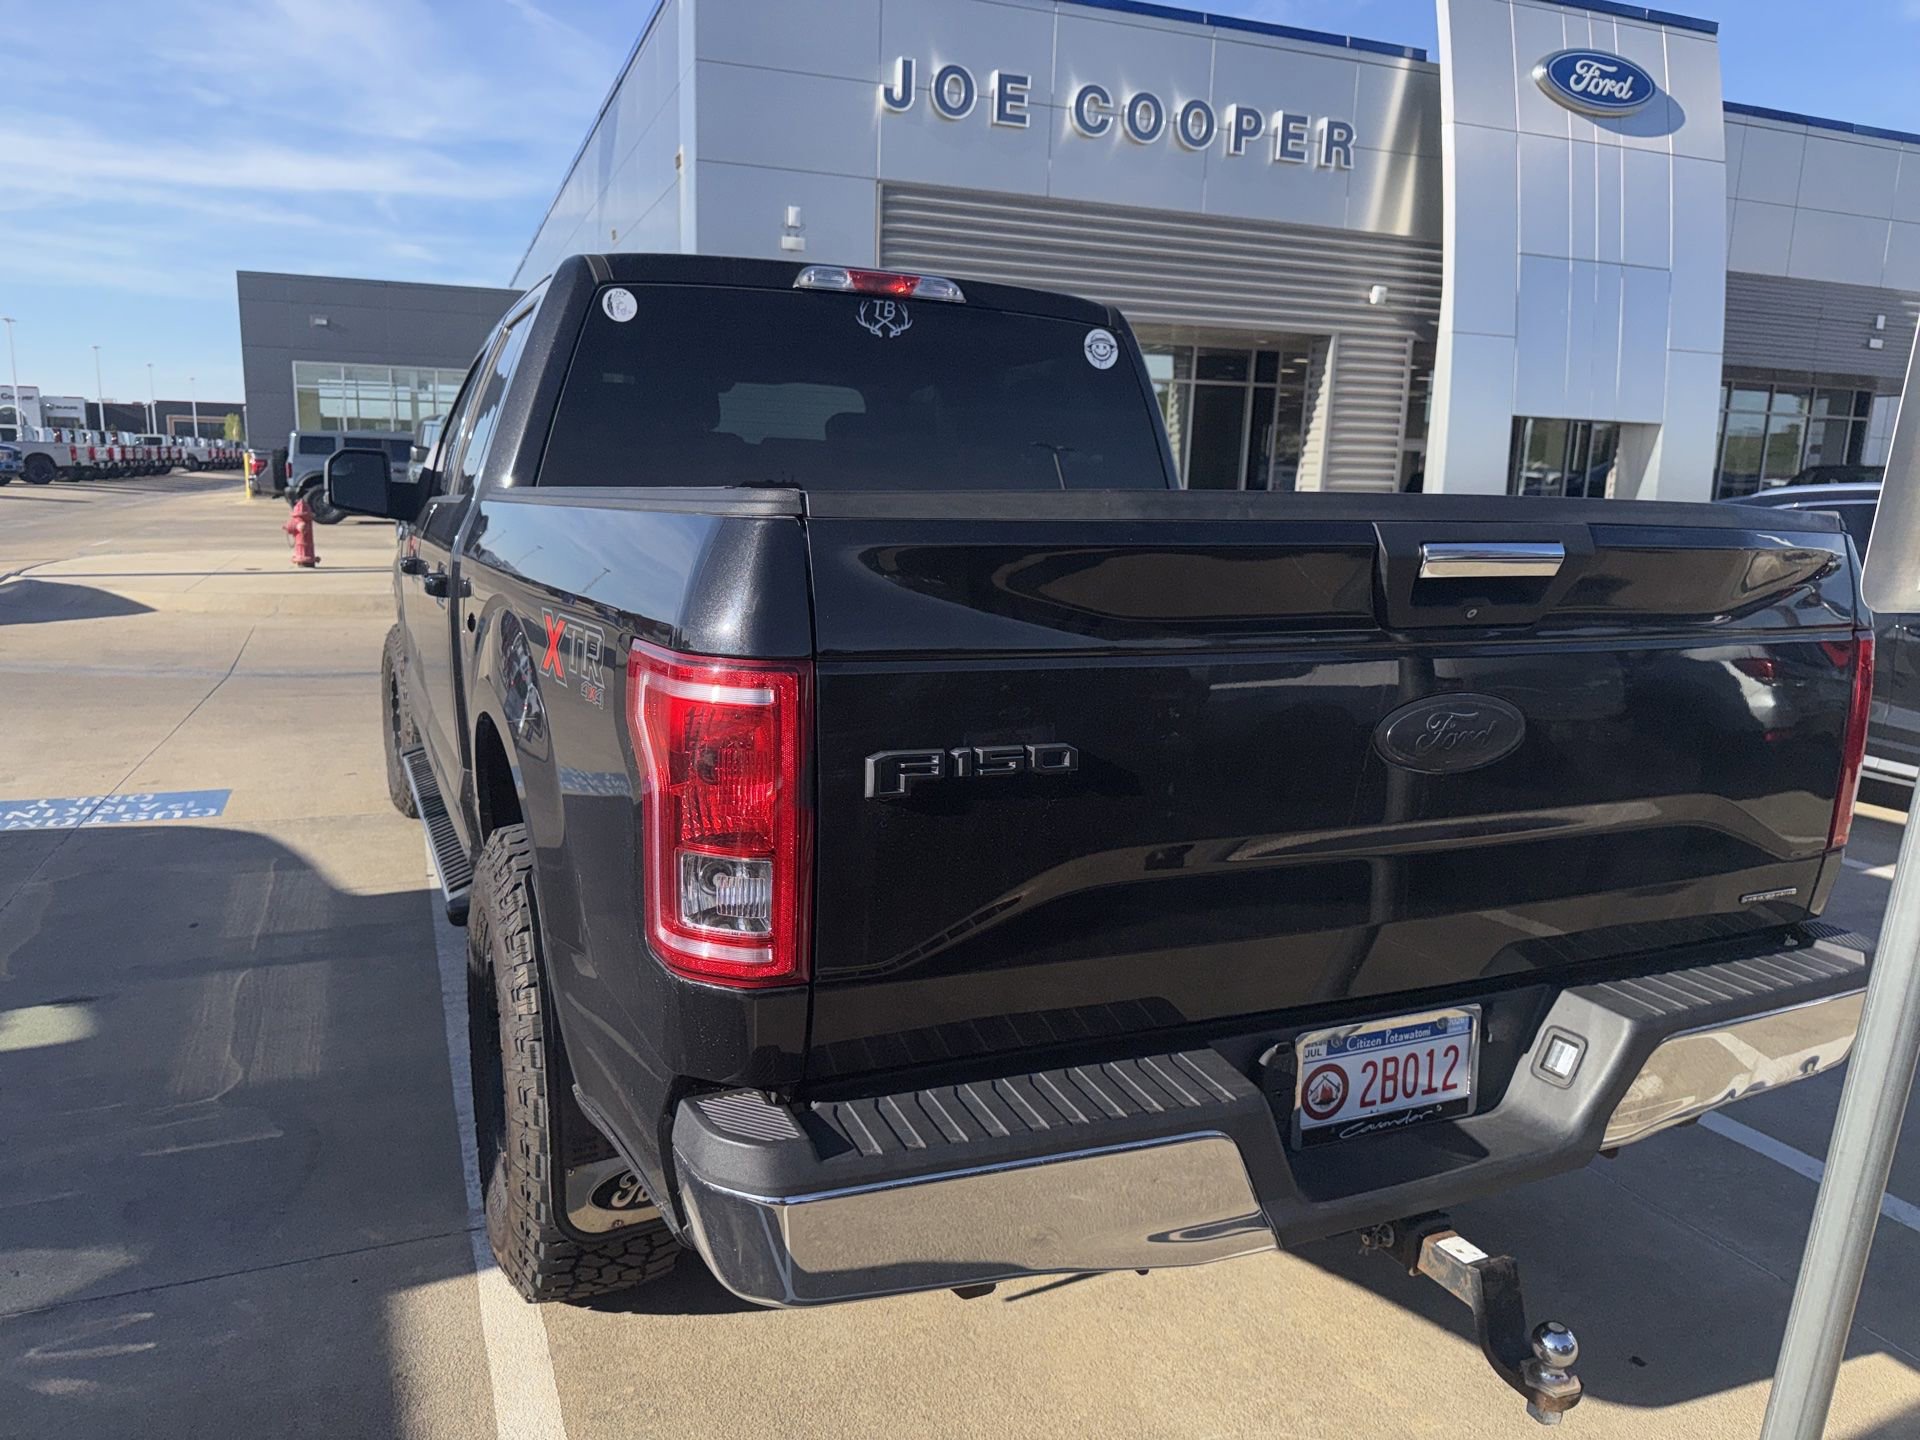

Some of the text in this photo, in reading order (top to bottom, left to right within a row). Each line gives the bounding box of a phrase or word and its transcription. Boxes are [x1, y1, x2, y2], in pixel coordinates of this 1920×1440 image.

[1569, 59, 1634, 100] Ford
[880, 56, 1358, 170] JOE COOPER
[539, 607, 605, 688] XTR
[1415, 711, 1497, 750] Ford
[0, 800, 196, 820] PARKIN
[0, 807, 217, 830] CUSTOM
[25, 793, 155, 809] ONLY
[1304, 1026, 1431, 1058] JUL Citizen Potawatomi
[1359, 1044, 1460, 1108] 2B012
[611, 1171, 650, 1208] Fo
